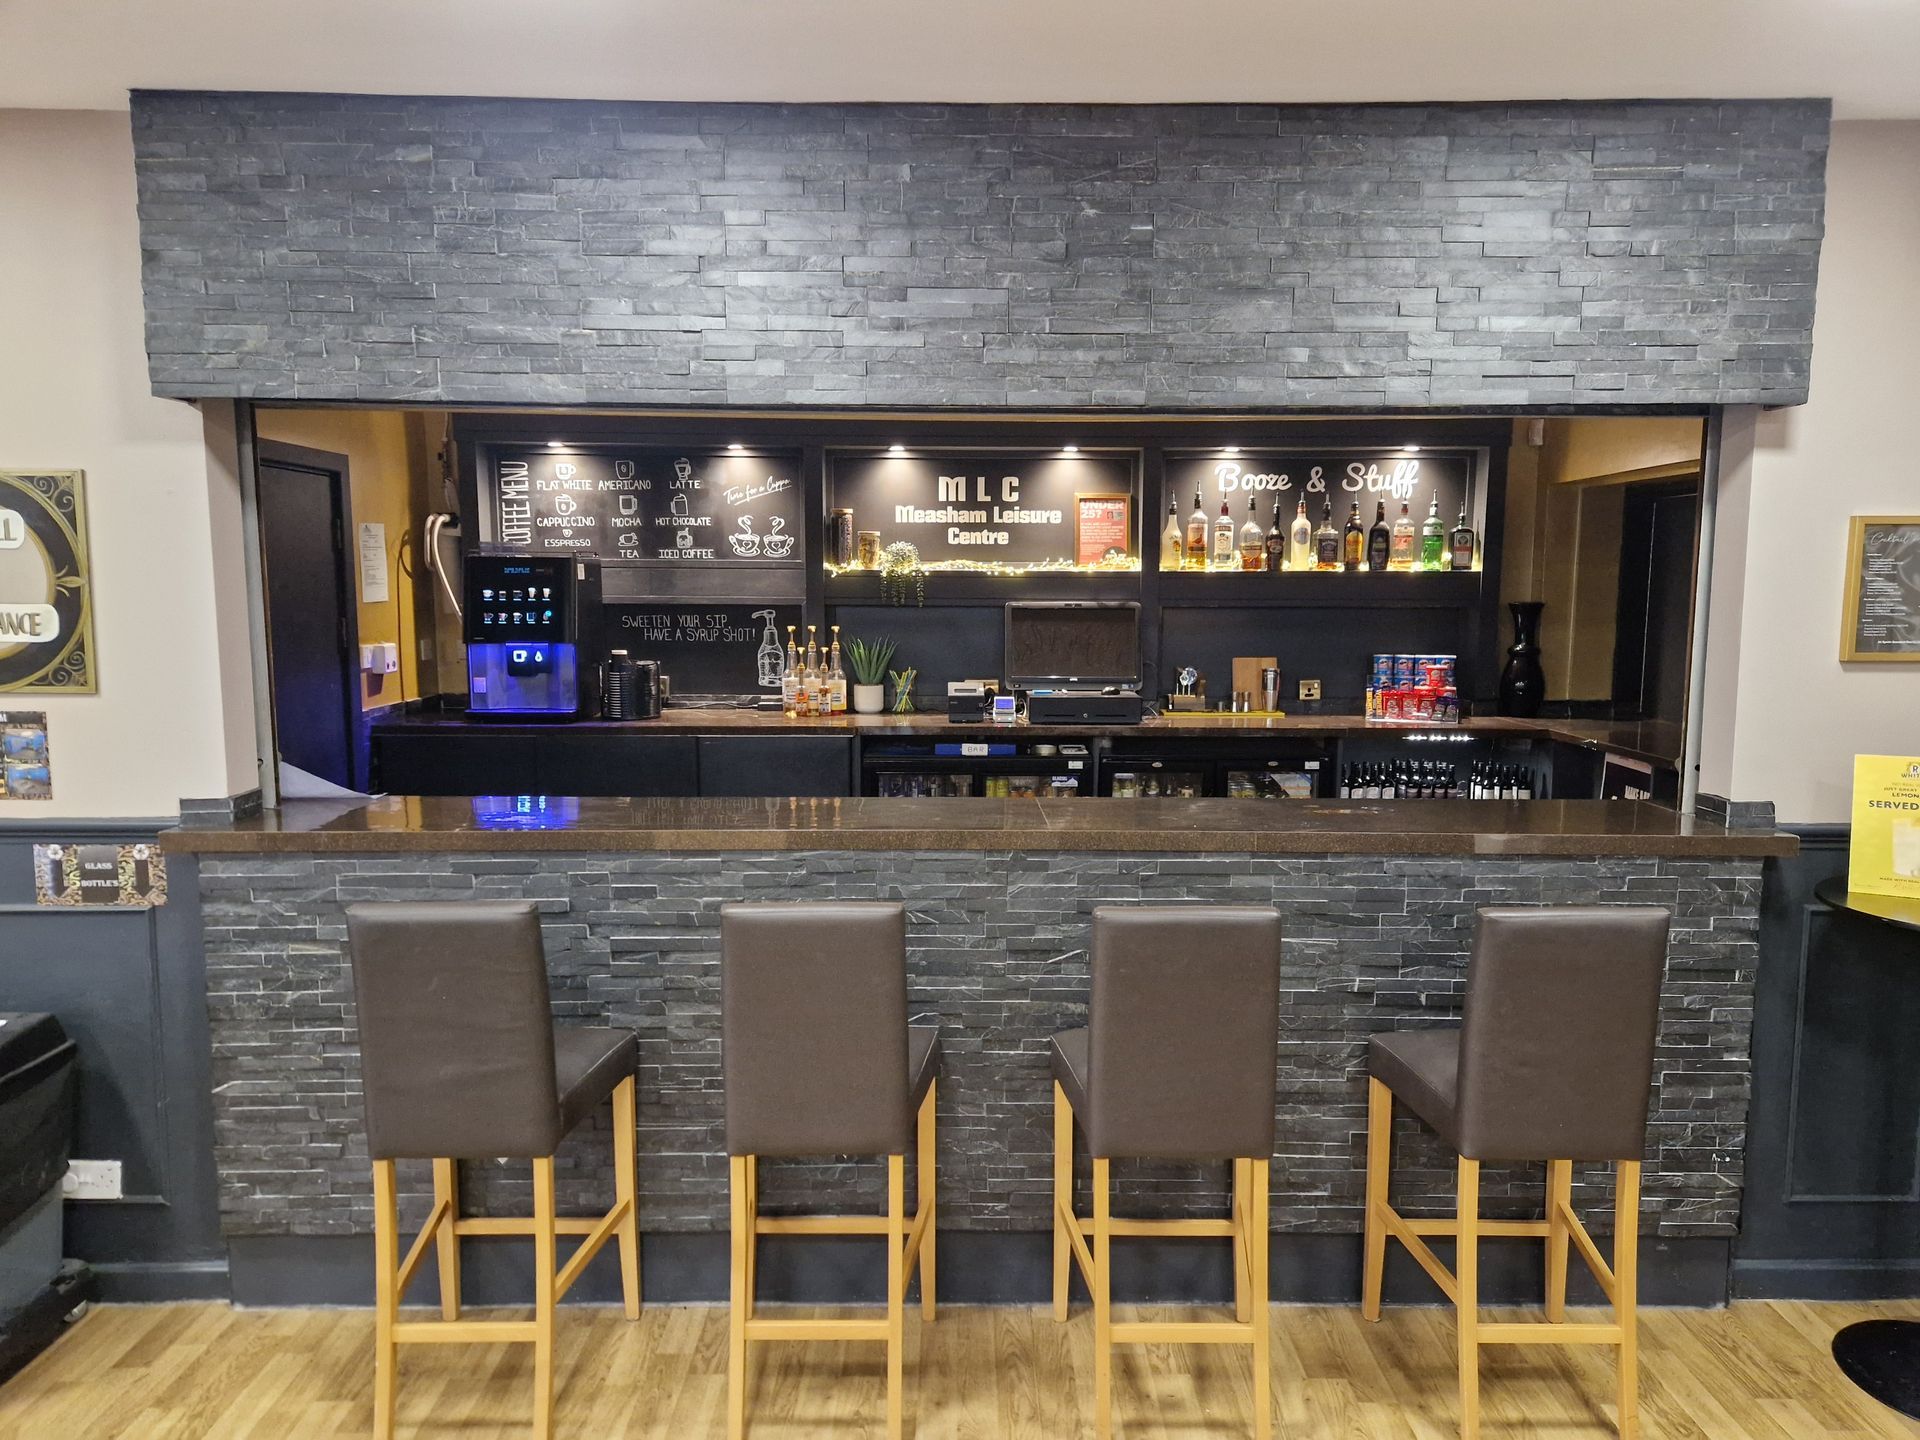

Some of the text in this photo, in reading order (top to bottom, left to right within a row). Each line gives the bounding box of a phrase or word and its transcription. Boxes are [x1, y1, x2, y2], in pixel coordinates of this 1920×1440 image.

[501, 461, 529, 499] MENU
[536, 480, 593, 491] FLAT WHITE
[598, 480, 651, 491] AMERICANO
[669, 480, 701, 490] LATTE
[1214, 460, 1420, 500] Booze & Stuff
[745, 484, 758, 502] for
[895, 505, 1063, 525] Measham Leisure
[536, 517, 596, 527] CAPPUCCINO
[611, 518, 642, 528] MOCHA
[655, 517, 712, 527] HOT CHOCOLATE
[947, 527, 1010, 546] Centre
[544, 538, 591, 548] ESSPRESSO
[619, 549, 640, 559] TEA
[659, 549, 715, 559] ICED COFFEE
[622, 615, 671, 628] SWEETEN
[677, 614, 701, 628] YOUR
[644, 627, 757, 642] HAVE A SYRUP SHOT!
[1868, 800, 1920, 811] SERVED
[85, 862, 113, 871] GLASS
